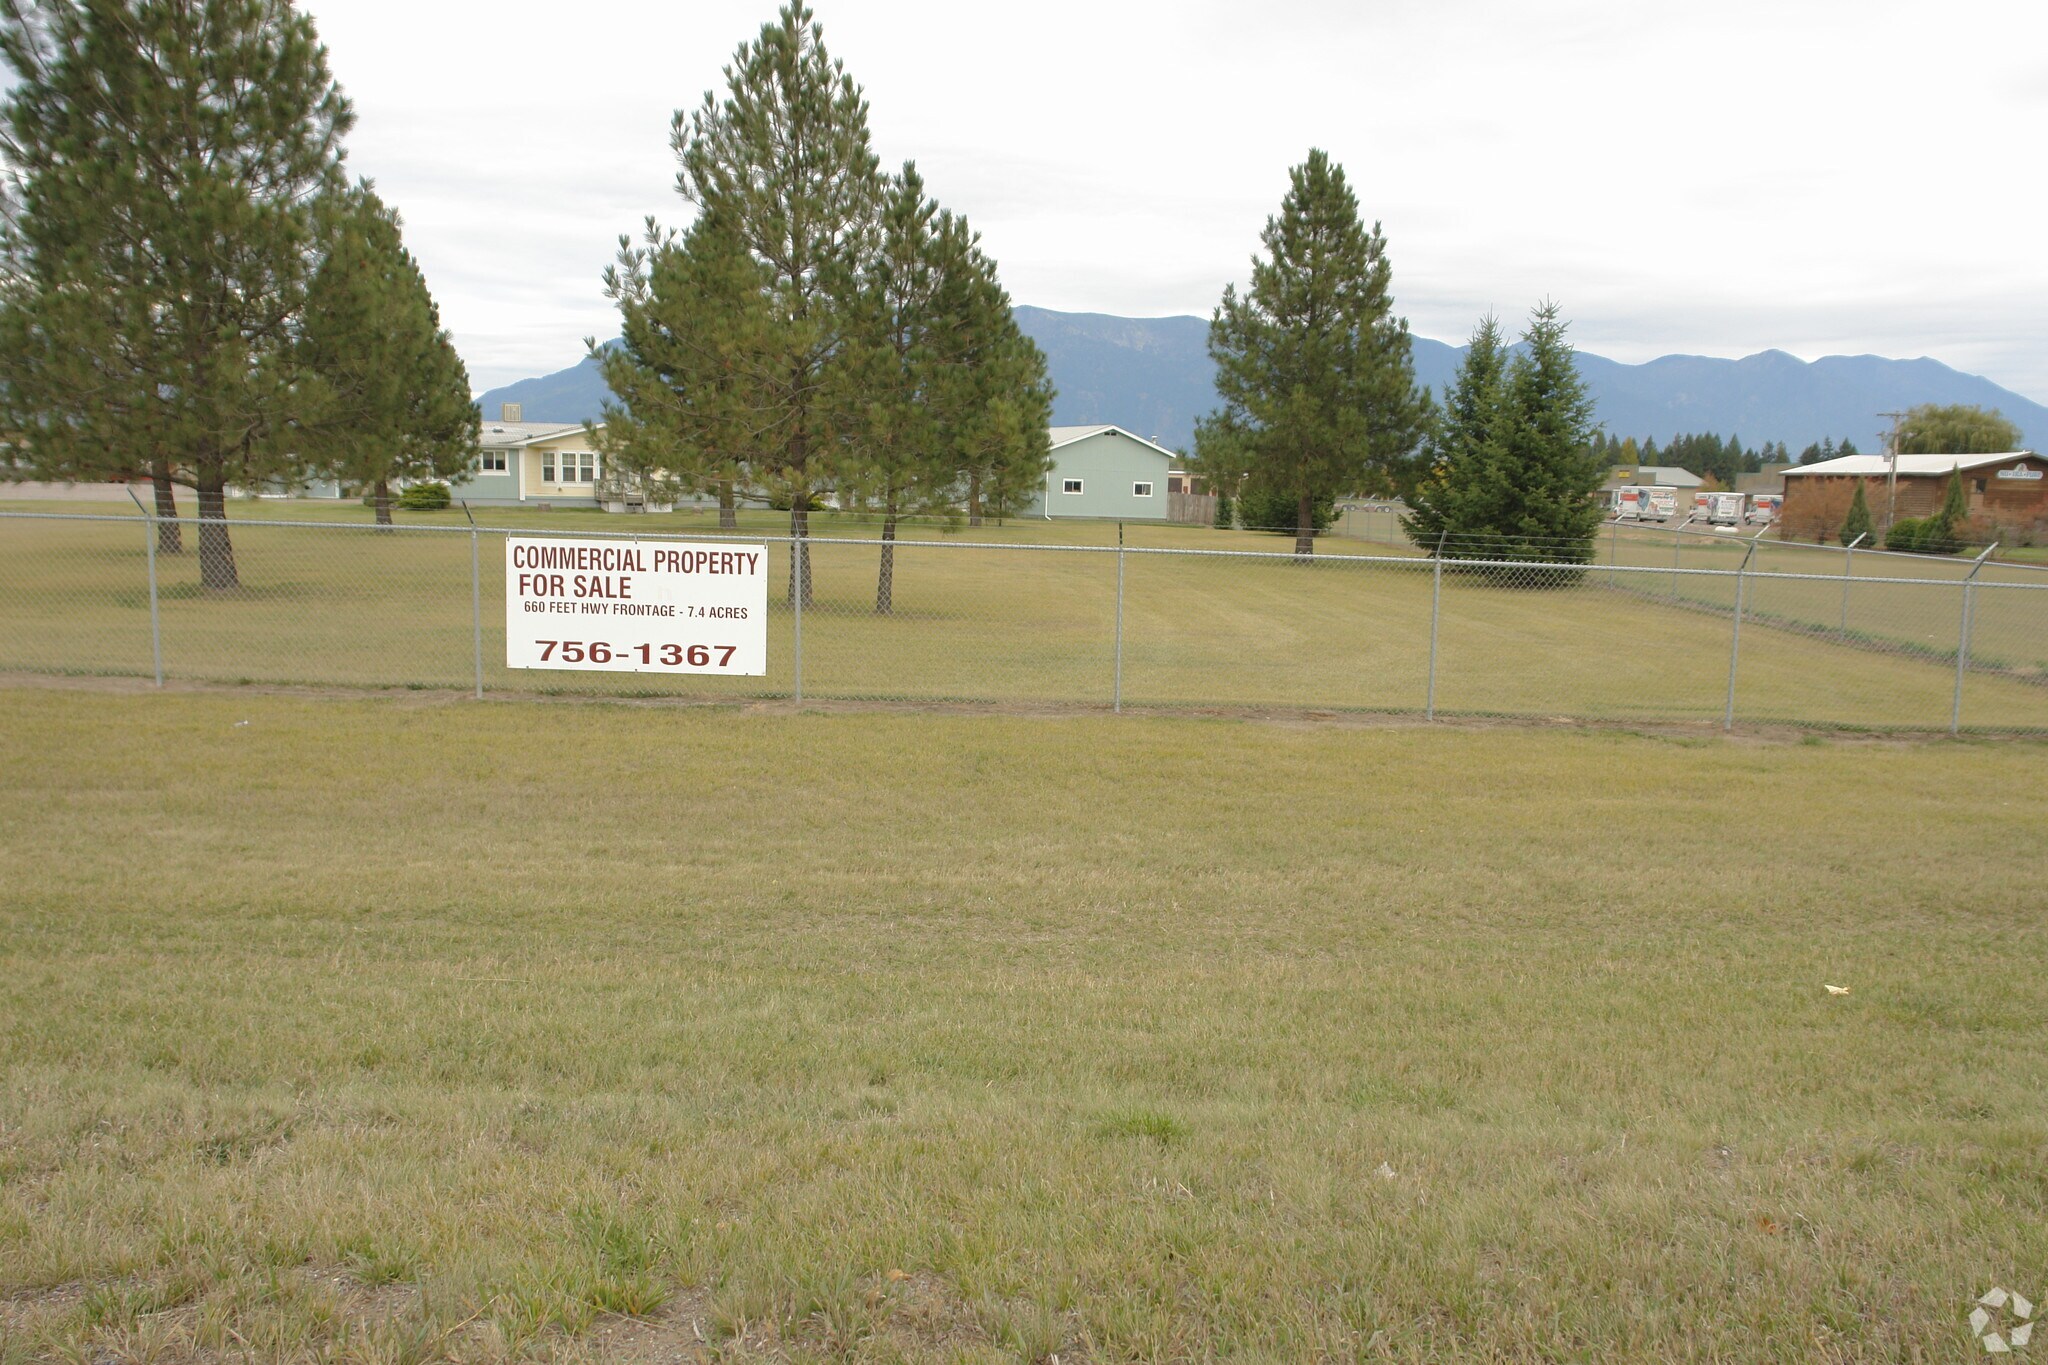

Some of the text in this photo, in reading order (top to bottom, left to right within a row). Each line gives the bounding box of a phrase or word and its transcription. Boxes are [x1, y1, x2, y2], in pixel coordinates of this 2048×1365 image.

[513, 545, 759, 575] COMMERCIAL PROPERTY
[519, 573, 631, 599] FOR SALE
[524, 601, 545, 613] 660
[550, 602, 577, 614] FEET
[581, 603, 608, 614] HWY
[613, 604, 675, 617] FRONTAGE
[687, 606, 705, 618] 7.4
[709, 607, 748, 619] ACRES
[535, 640, 737, 667] 756-1367
